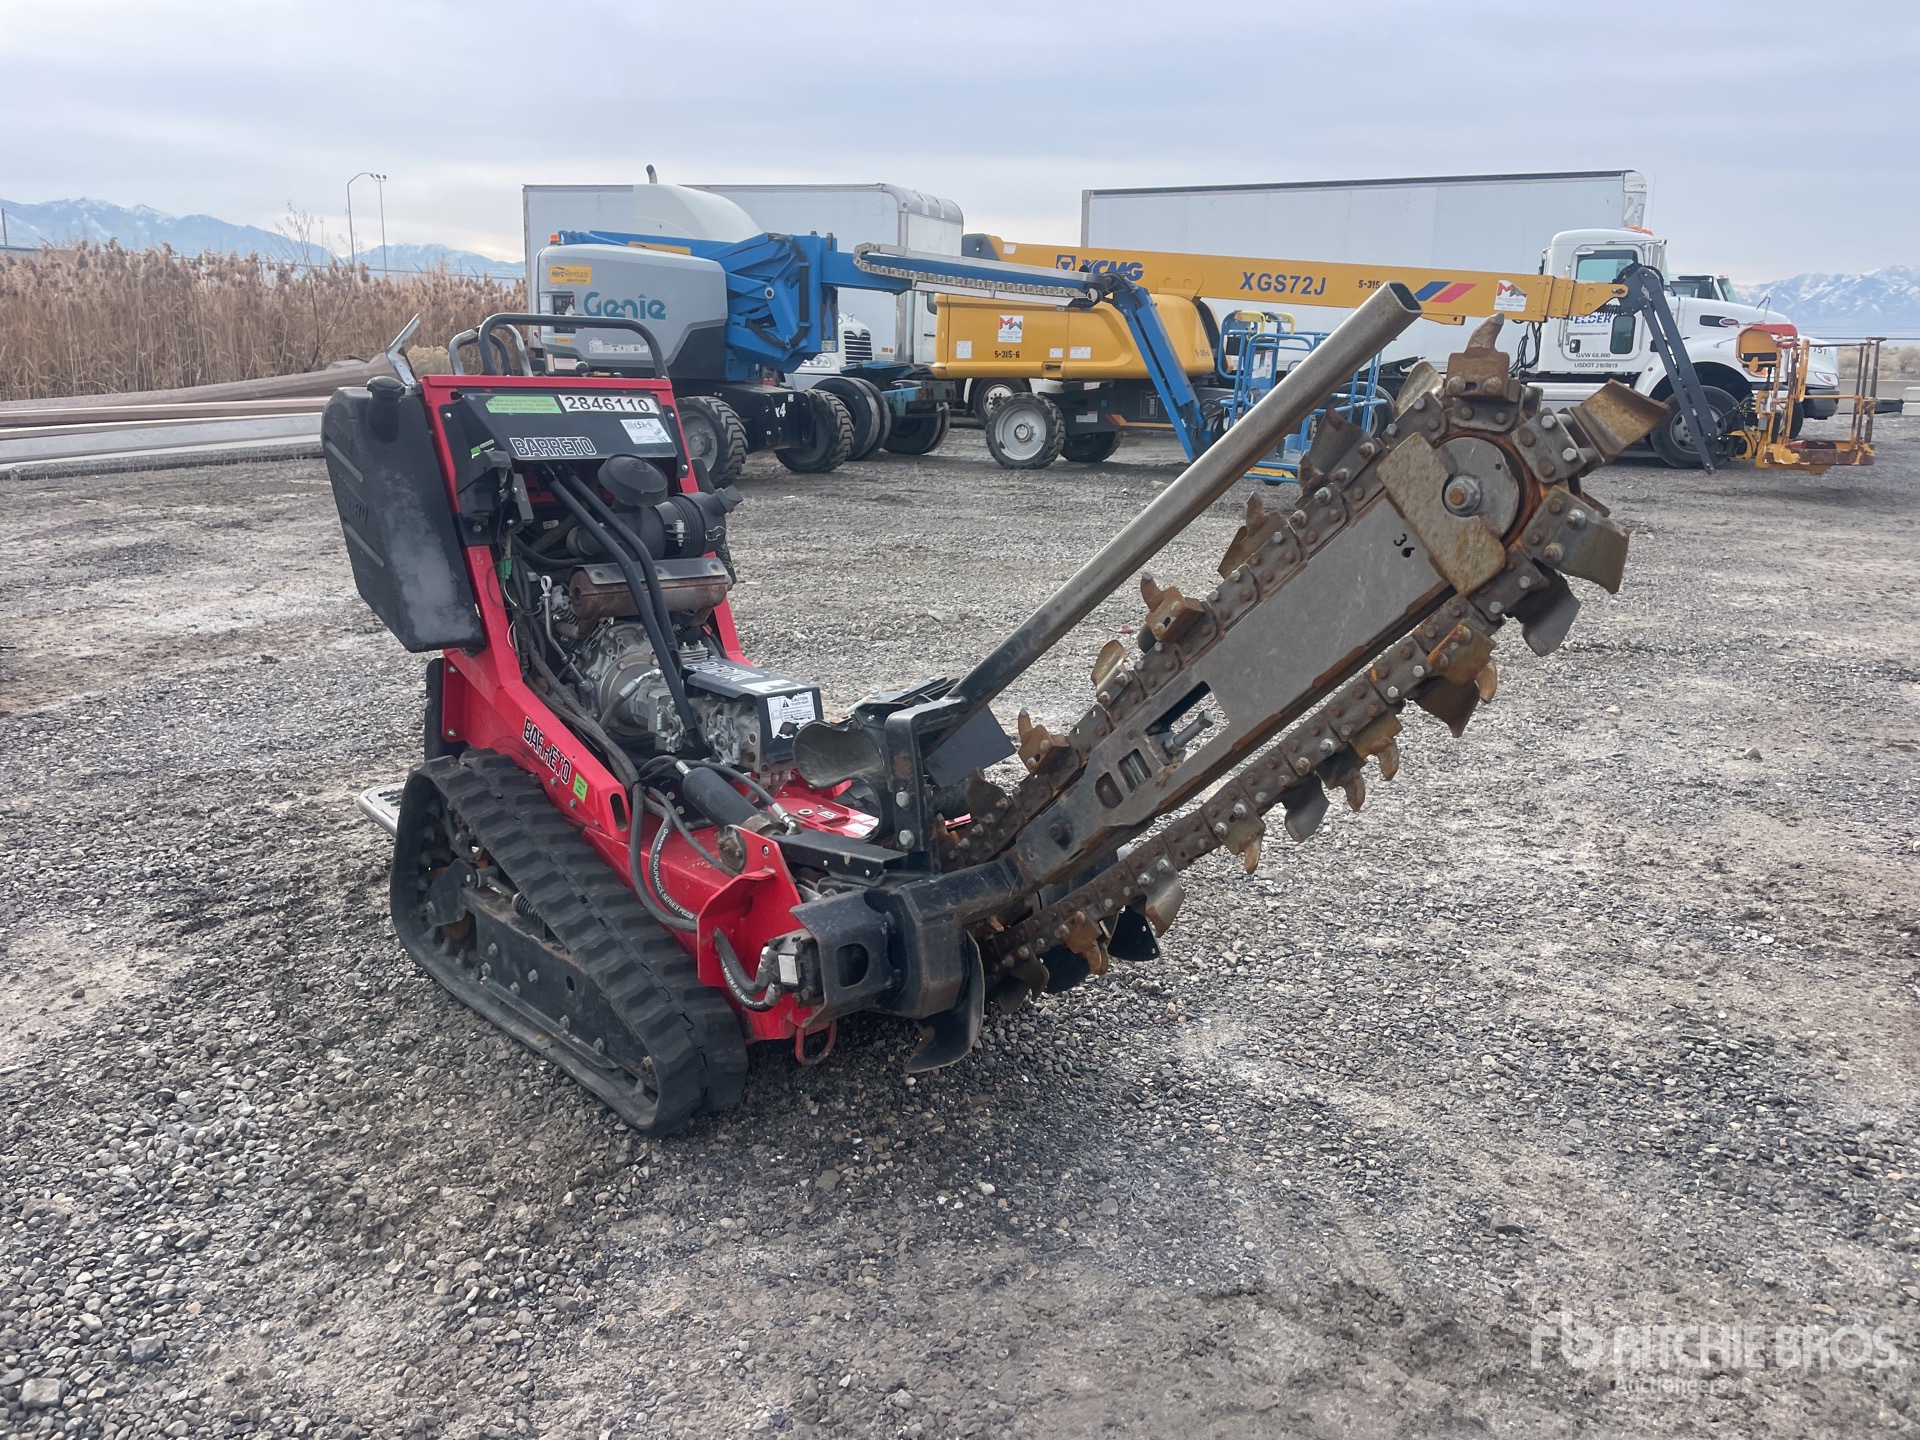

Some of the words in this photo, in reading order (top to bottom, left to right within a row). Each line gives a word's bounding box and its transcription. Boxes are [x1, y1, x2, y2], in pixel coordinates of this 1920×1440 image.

[1240, 272, 1326, 296] XGS72J
[583, 291, 666, 320] Genie
[994, 350, 1020, 359] 5-315-6
[564, 396, 650, 412] 2846110
[509, 436, 597, 458] BARRETO
